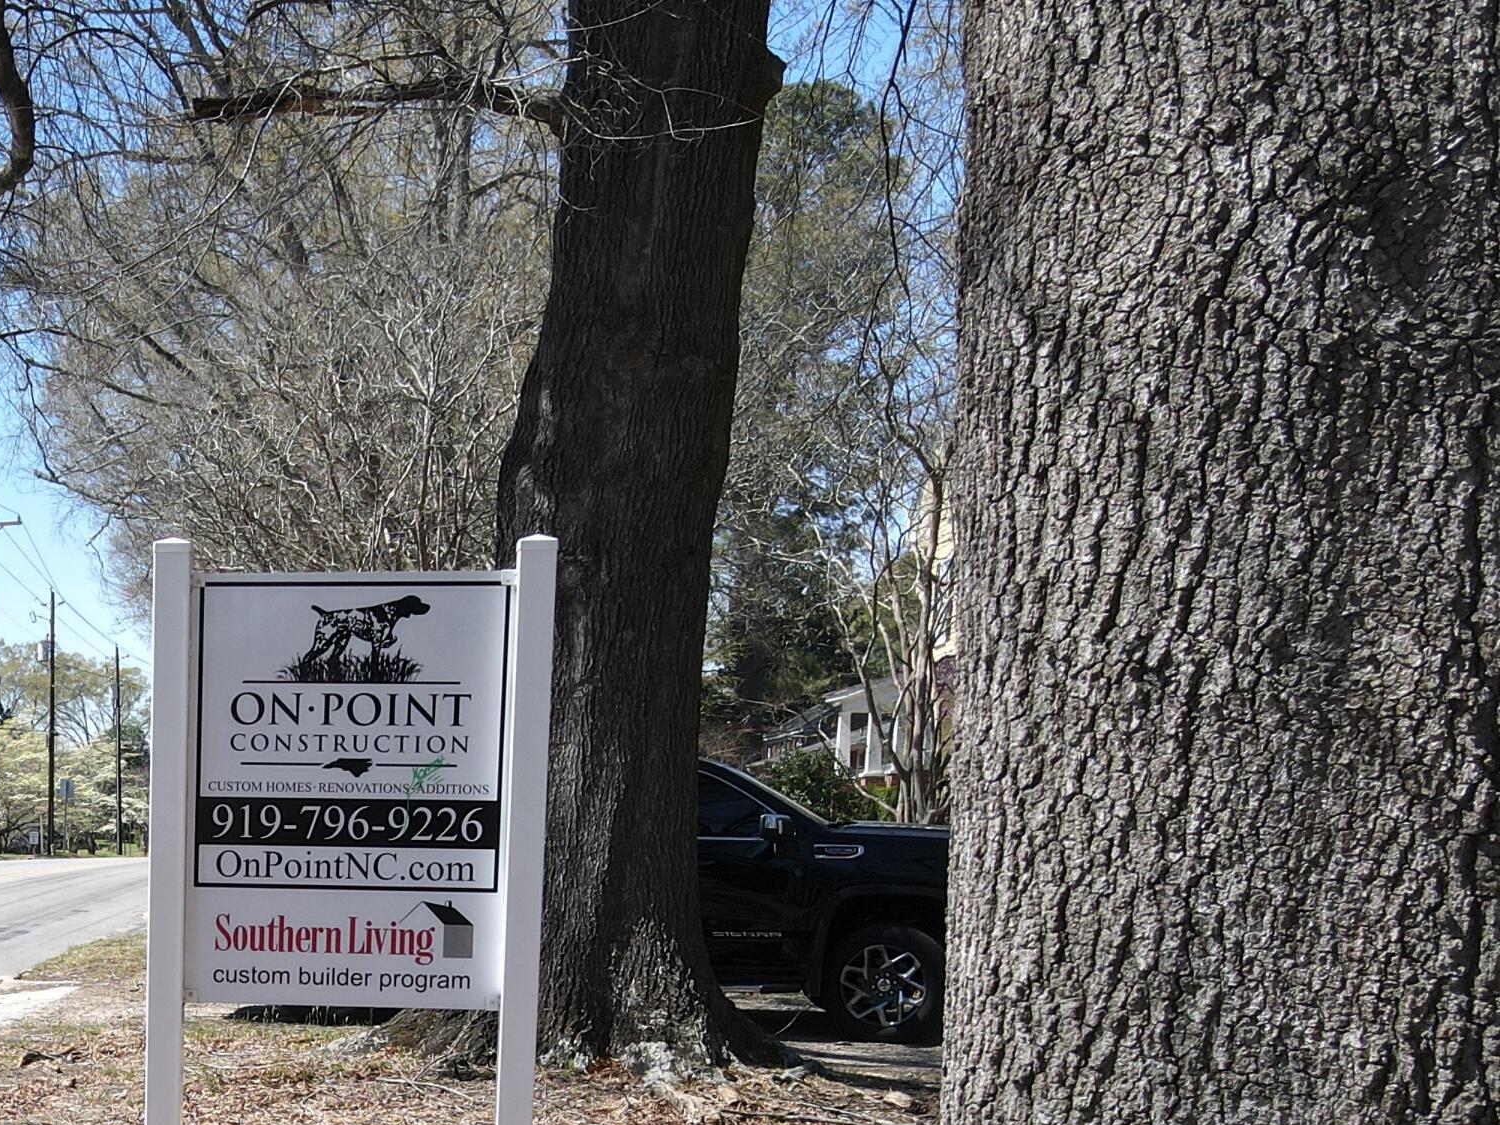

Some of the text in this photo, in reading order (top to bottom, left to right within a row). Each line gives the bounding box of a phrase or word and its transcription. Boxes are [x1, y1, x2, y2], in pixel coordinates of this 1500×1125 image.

[229, 732, 470, 754] CONSTRUCTION
[207, 780, 263, 793] CUSTOM
[211, 803, 484, 843] 919-796-9226
[215, 850, 476, 883] OnPointNC.com
[214, 912, 436, 966] Southern Living
[212, 966, 472, 993] custom builder program
